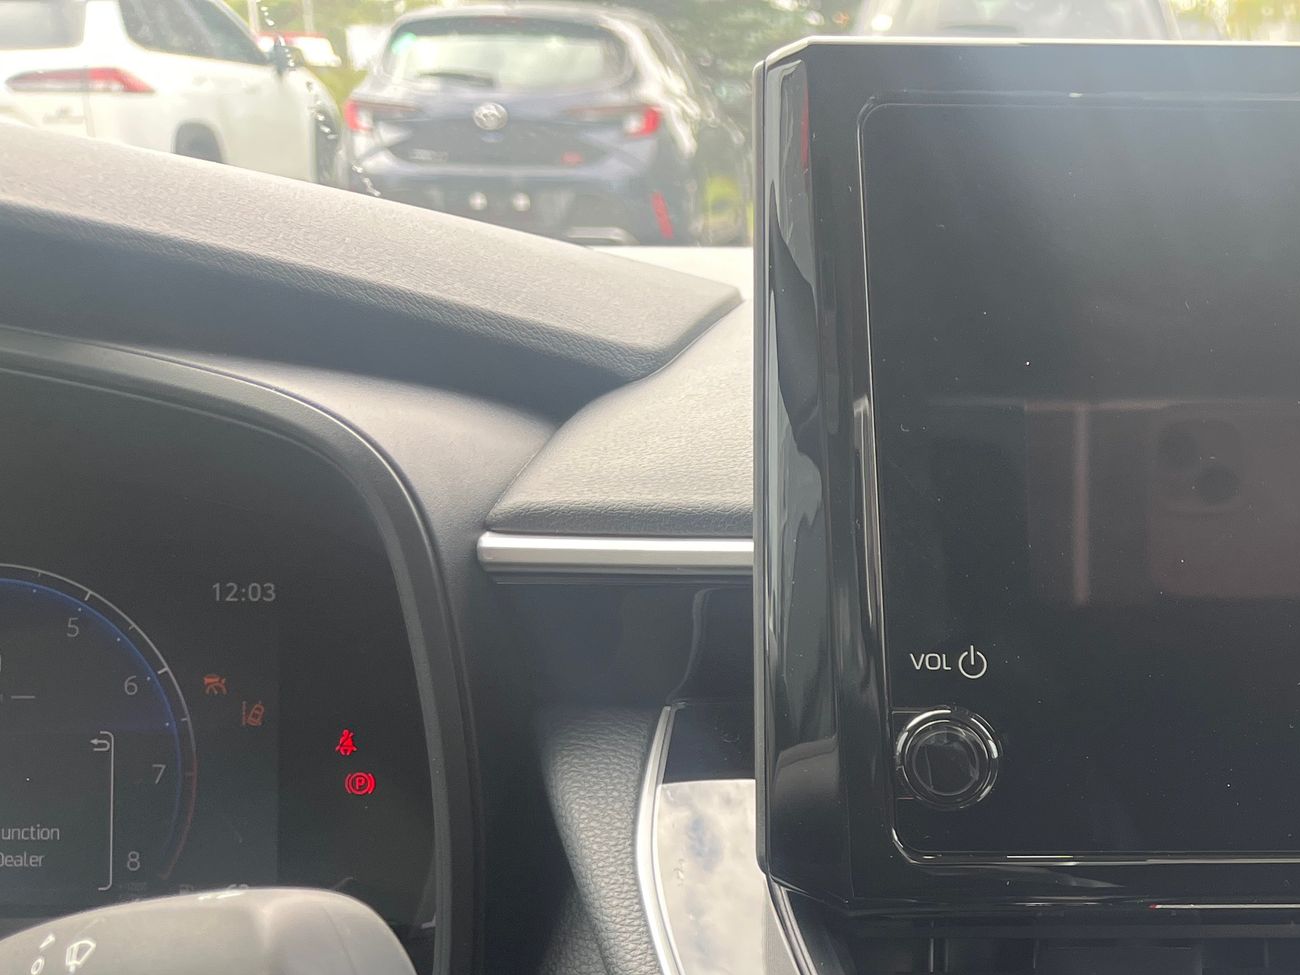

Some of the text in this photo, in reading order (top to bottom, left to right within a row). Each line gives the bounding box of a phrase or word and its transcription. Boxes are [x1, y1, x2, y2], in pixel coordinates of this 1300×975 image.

[212, 582, 277, 602] 12:03
[67, 617, 81, 638] 5
[909, 653, 952, 670] VOL
[124, 675, 138, 696] 6
[152, 764, 166, 785] 7
[127, 850, 141, 872] 8
